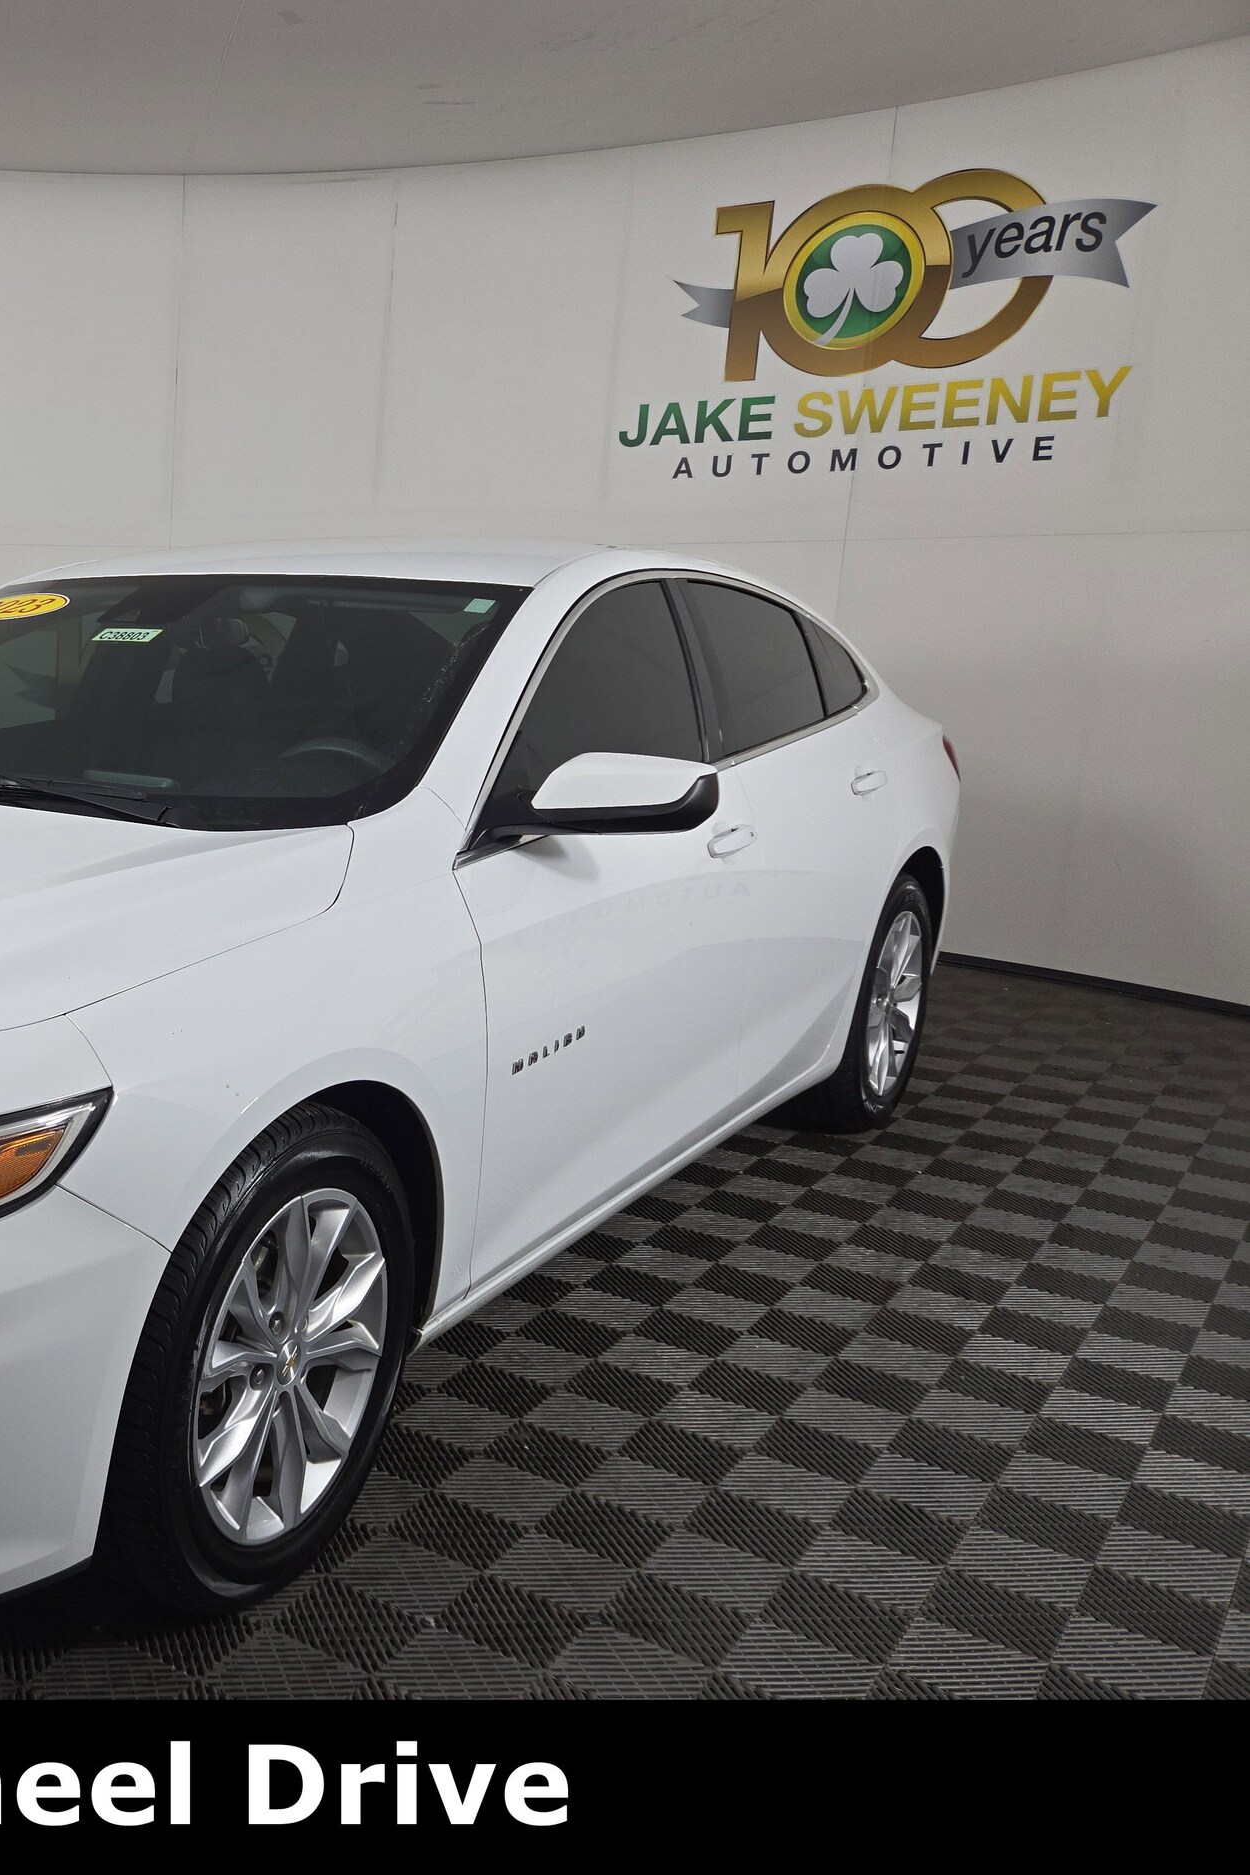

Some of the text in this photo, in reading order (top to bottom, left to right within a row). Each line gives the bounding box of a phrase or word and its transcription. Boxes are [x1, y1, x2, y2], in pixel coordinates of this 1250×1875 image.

[715, 168, 1054, 382] 100
[960, 211, 1108, 278] years
[618, 365, 1134, 449] JAKE SWEENEY
[672, 435, 1056, 480] AUTOMOTIVE
[99, 631, 150, 641] C38803
